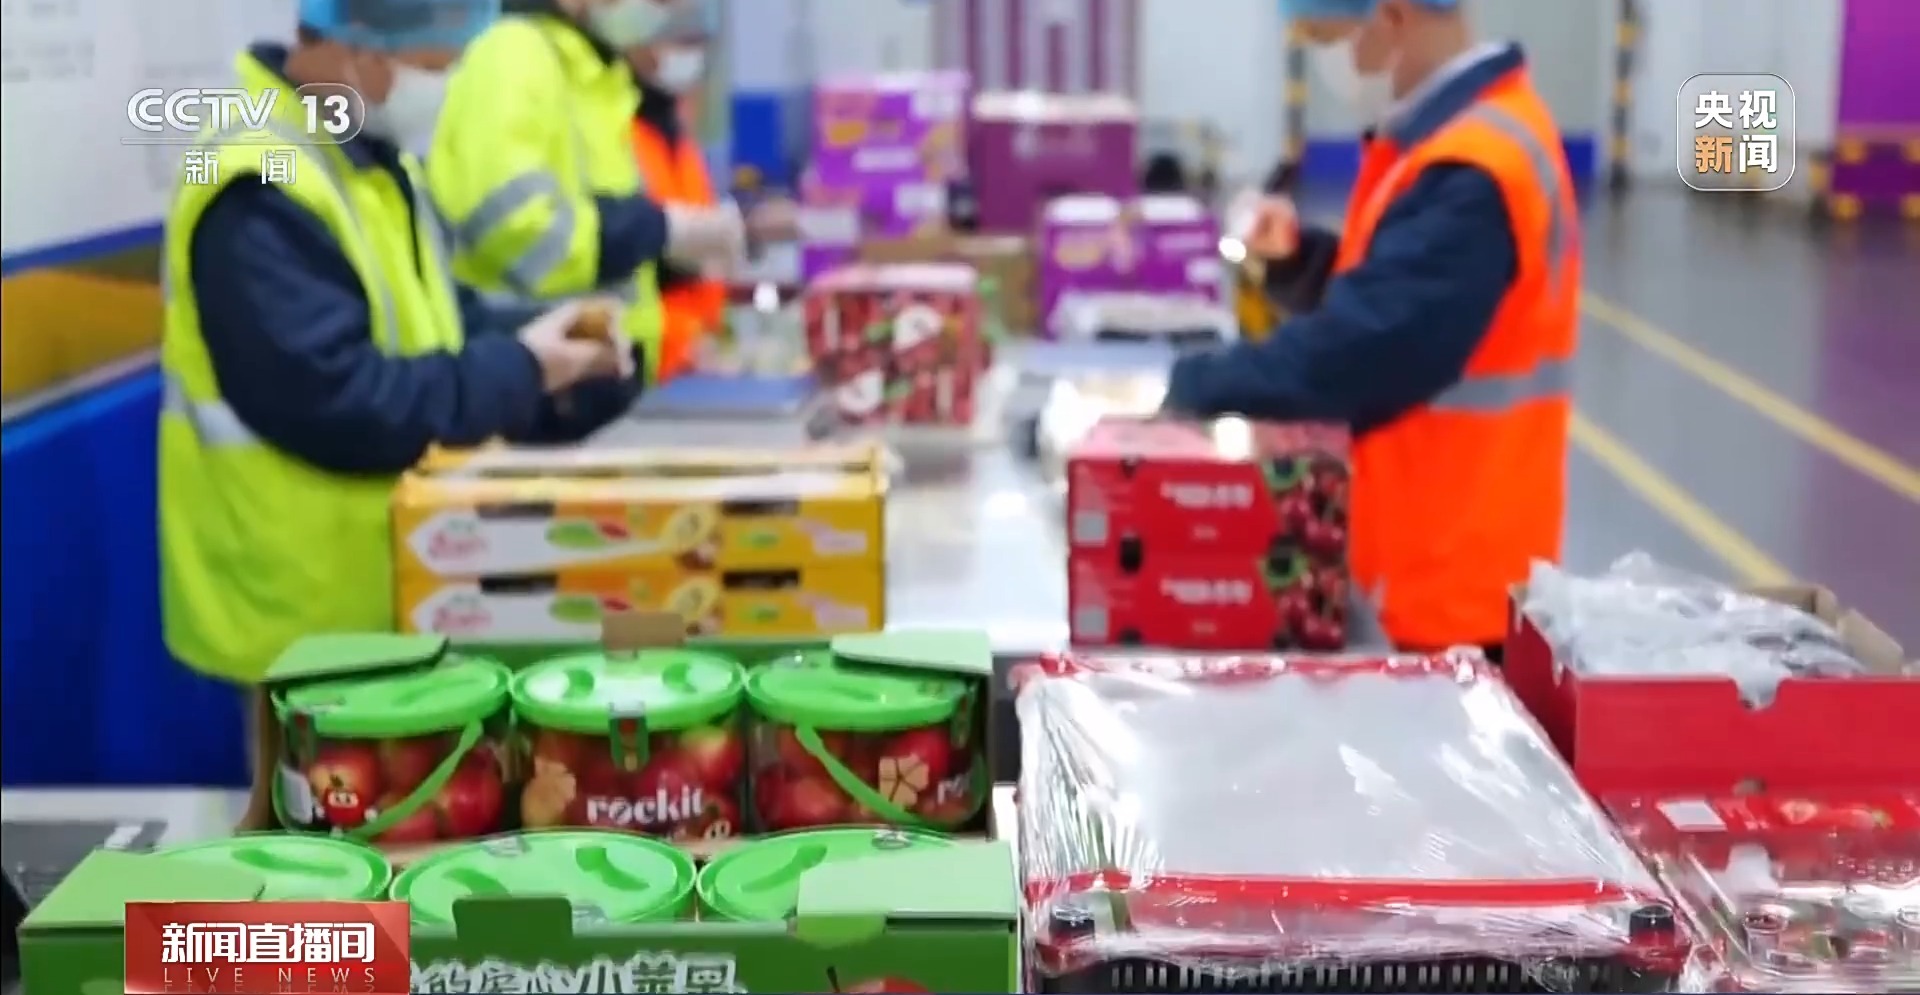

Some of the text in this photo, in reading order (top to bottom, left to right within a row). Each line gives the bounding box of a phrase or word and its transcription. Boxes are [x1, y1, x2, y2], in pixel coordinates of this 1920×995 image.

[586, 785, 703, 826] rockit
[411, 952, 737, 994] 的安心小苹果
